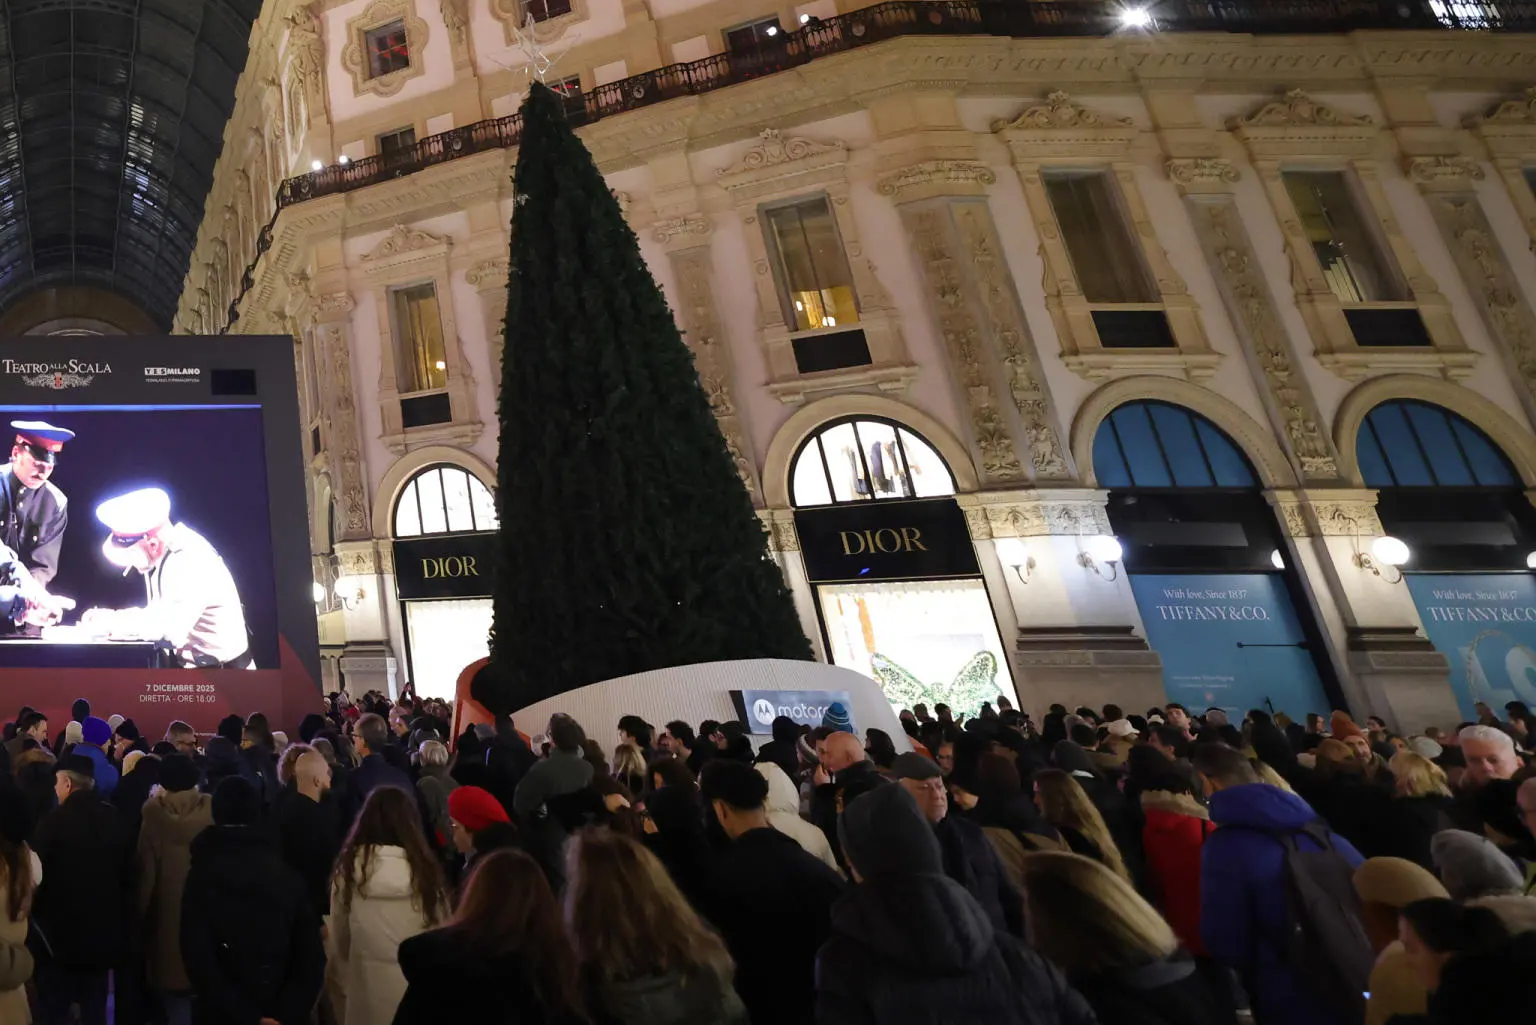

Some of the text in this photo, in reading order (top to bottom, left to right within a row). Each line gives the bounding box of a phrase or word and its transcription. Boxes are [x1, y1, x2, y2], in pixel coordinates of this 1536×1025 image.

[2, 359, 49, 373] TEATRO
[68, 359, 112, 373] SCALA
[839, 527, 931, 556] DIOR
[421, 556, 480, 579] DIOR
[1164, 589, 1185, 600] With
[1206, 589, 1227, 600] Since
[1228, 589, 1247, 600] 1837
[1432, 589, 1455, 601] With
[146, 684, 215, 692] 7 DICEMBRE 2025
[139, 695, 172, 703] DIRETTA
[177, 695, 195, 703] ORE
[778, 704, 828, 719] motor
